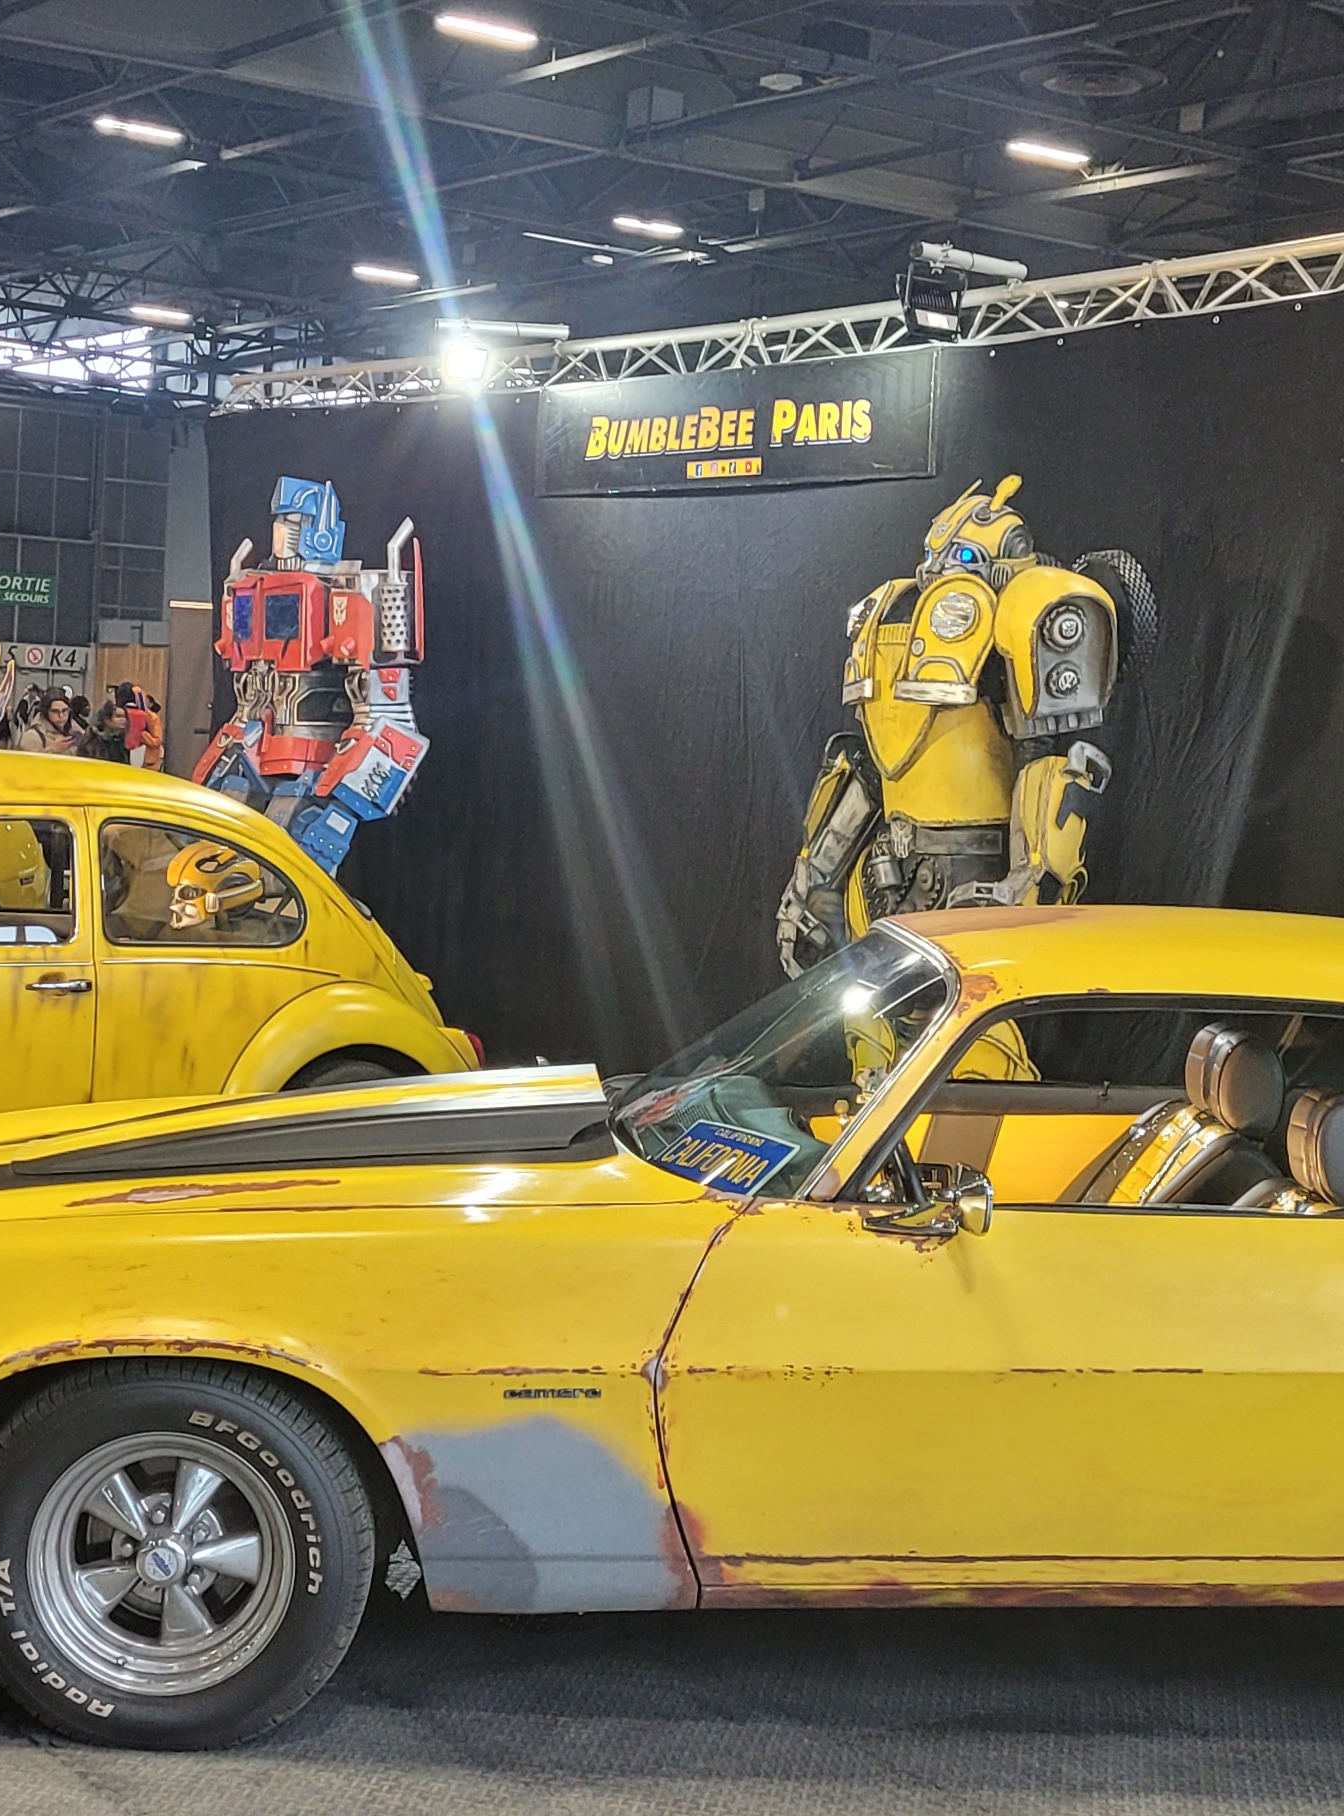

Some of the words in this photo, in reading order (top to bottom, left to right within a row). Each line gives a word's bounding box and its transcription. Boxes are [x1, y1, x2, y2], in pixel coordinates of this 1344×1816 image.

[3, 592, 50, 604] SECOURS
[49, 647, 78, 668] K4
[187, 1409, 325, 1596] BFGoodrich
[10, 1629, 117, 1719] Radial
